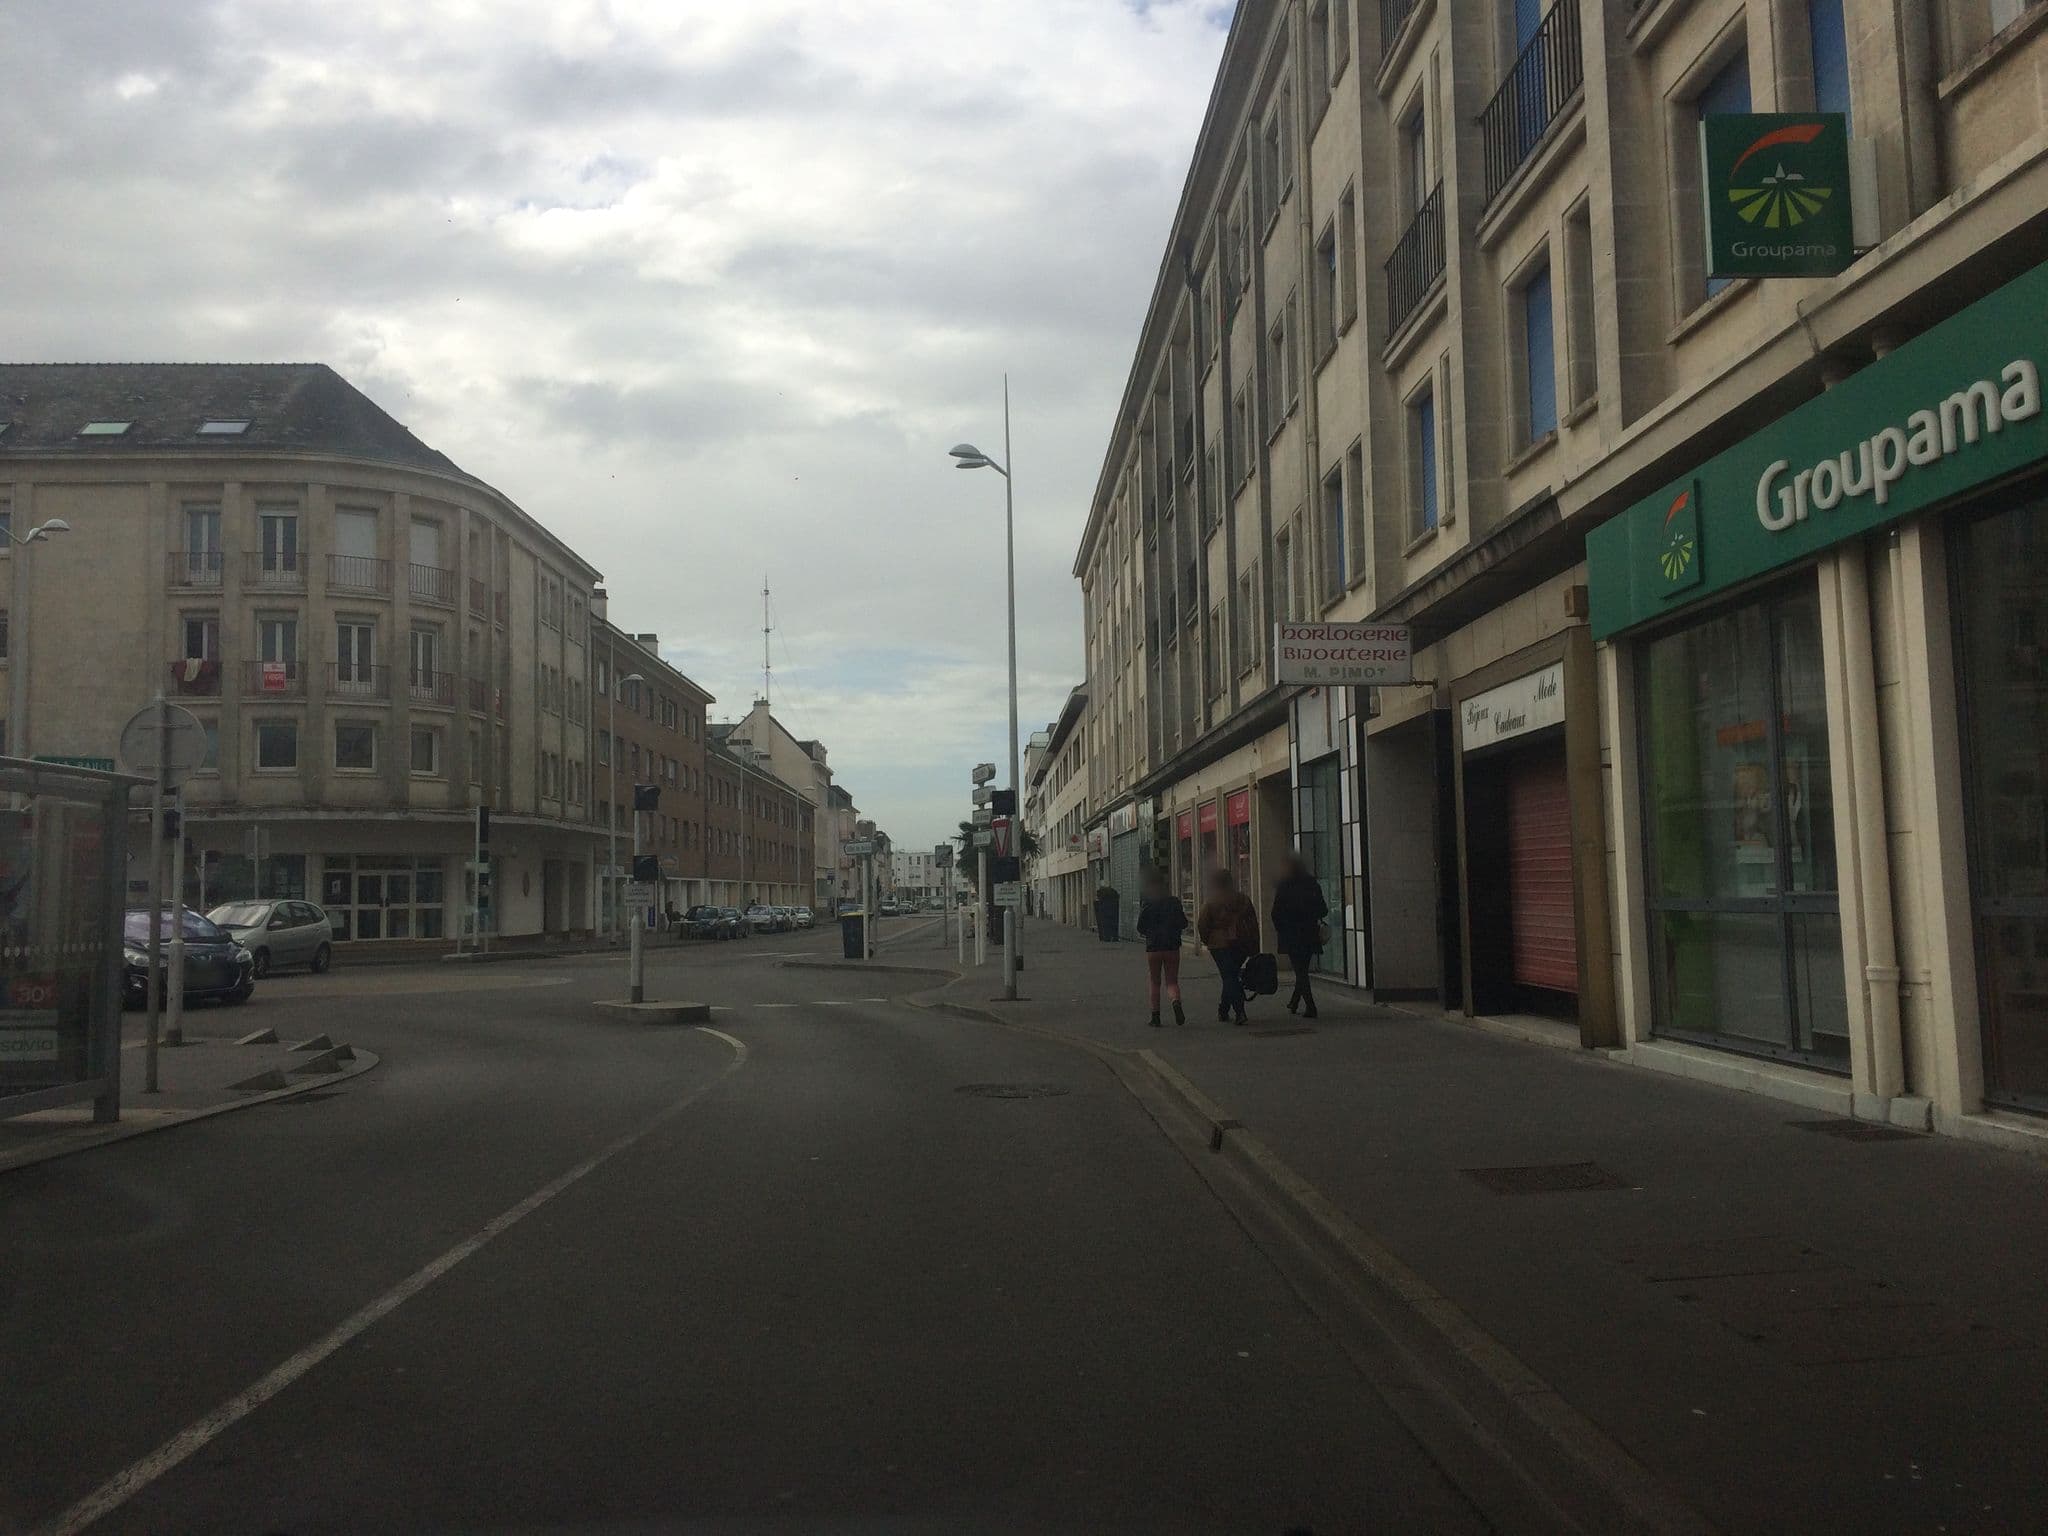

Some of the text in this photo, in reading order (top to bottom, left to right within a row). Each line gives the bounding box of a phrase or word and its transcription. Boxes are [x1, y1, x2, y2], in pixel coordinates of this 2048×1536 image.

[1731, 241, 1837, 260] Groupama
[1757, 359, 2042, 532] Groupama
[1281, 625, 1408, 641] HORLOGERIE
[1283, 647, 1408, 661] BIJOUTERIE
[1303, 666, 1321, 679] M.
[1533, 671, 1557, 703] Mode
[1466, 702, 1490, 732] Bijoux
[1493, 707, 1527, 735] Cadeaux
